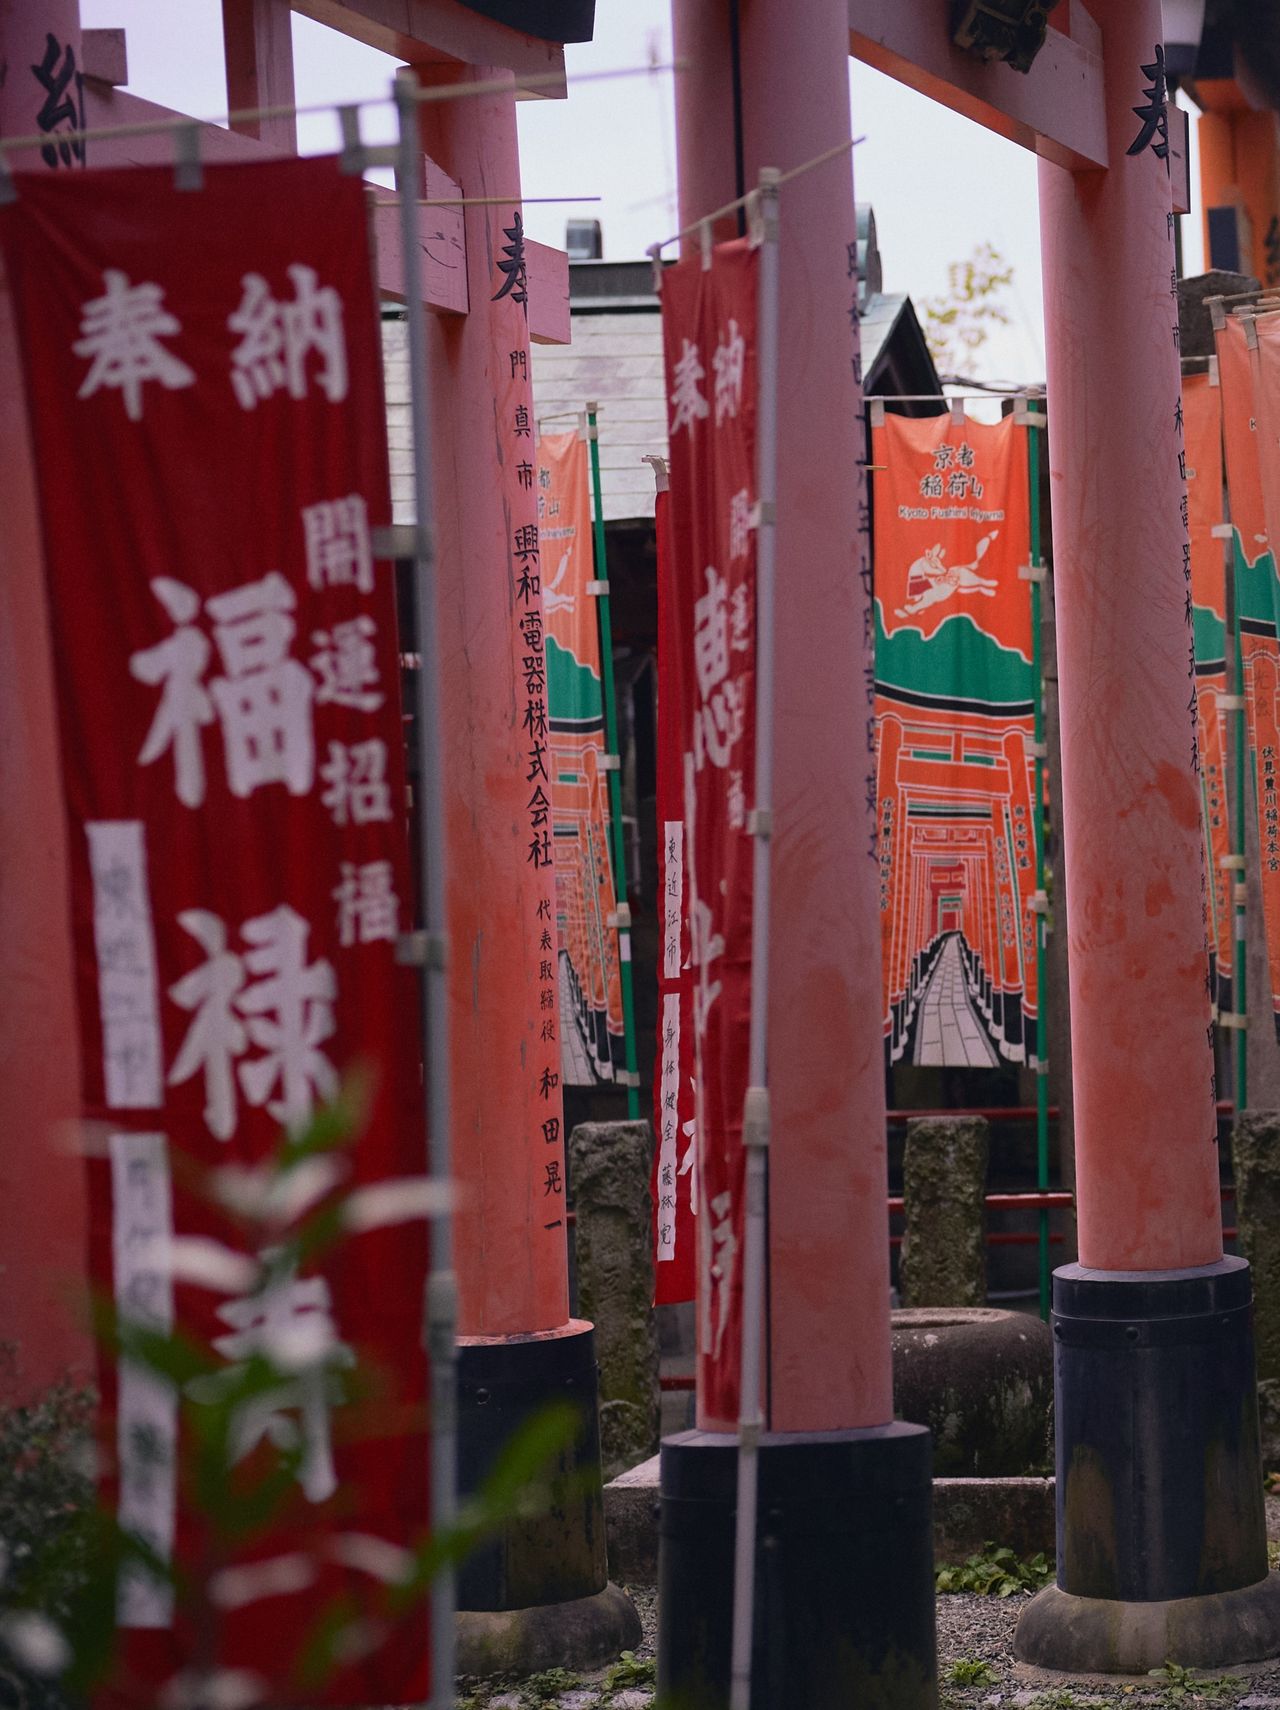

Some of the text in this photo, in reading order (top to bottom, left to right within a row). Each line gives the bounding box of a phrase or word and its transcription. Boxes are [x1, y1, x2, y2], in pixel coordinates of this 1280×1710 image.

[73, 263, 348, 420] 奉納
[671, 318, 745, 440] 奉納
[509, 349, 533, 491] 門真市
[899, 505, 928, 520] Kyoto
[303, 495, 399, 948] 開運招福
[513, 527, 553, 869] 興和電器株式会社
[536, 899, 555, 1041] 代表取締役
[539, 1067, 562, 1231] 和田晃一
